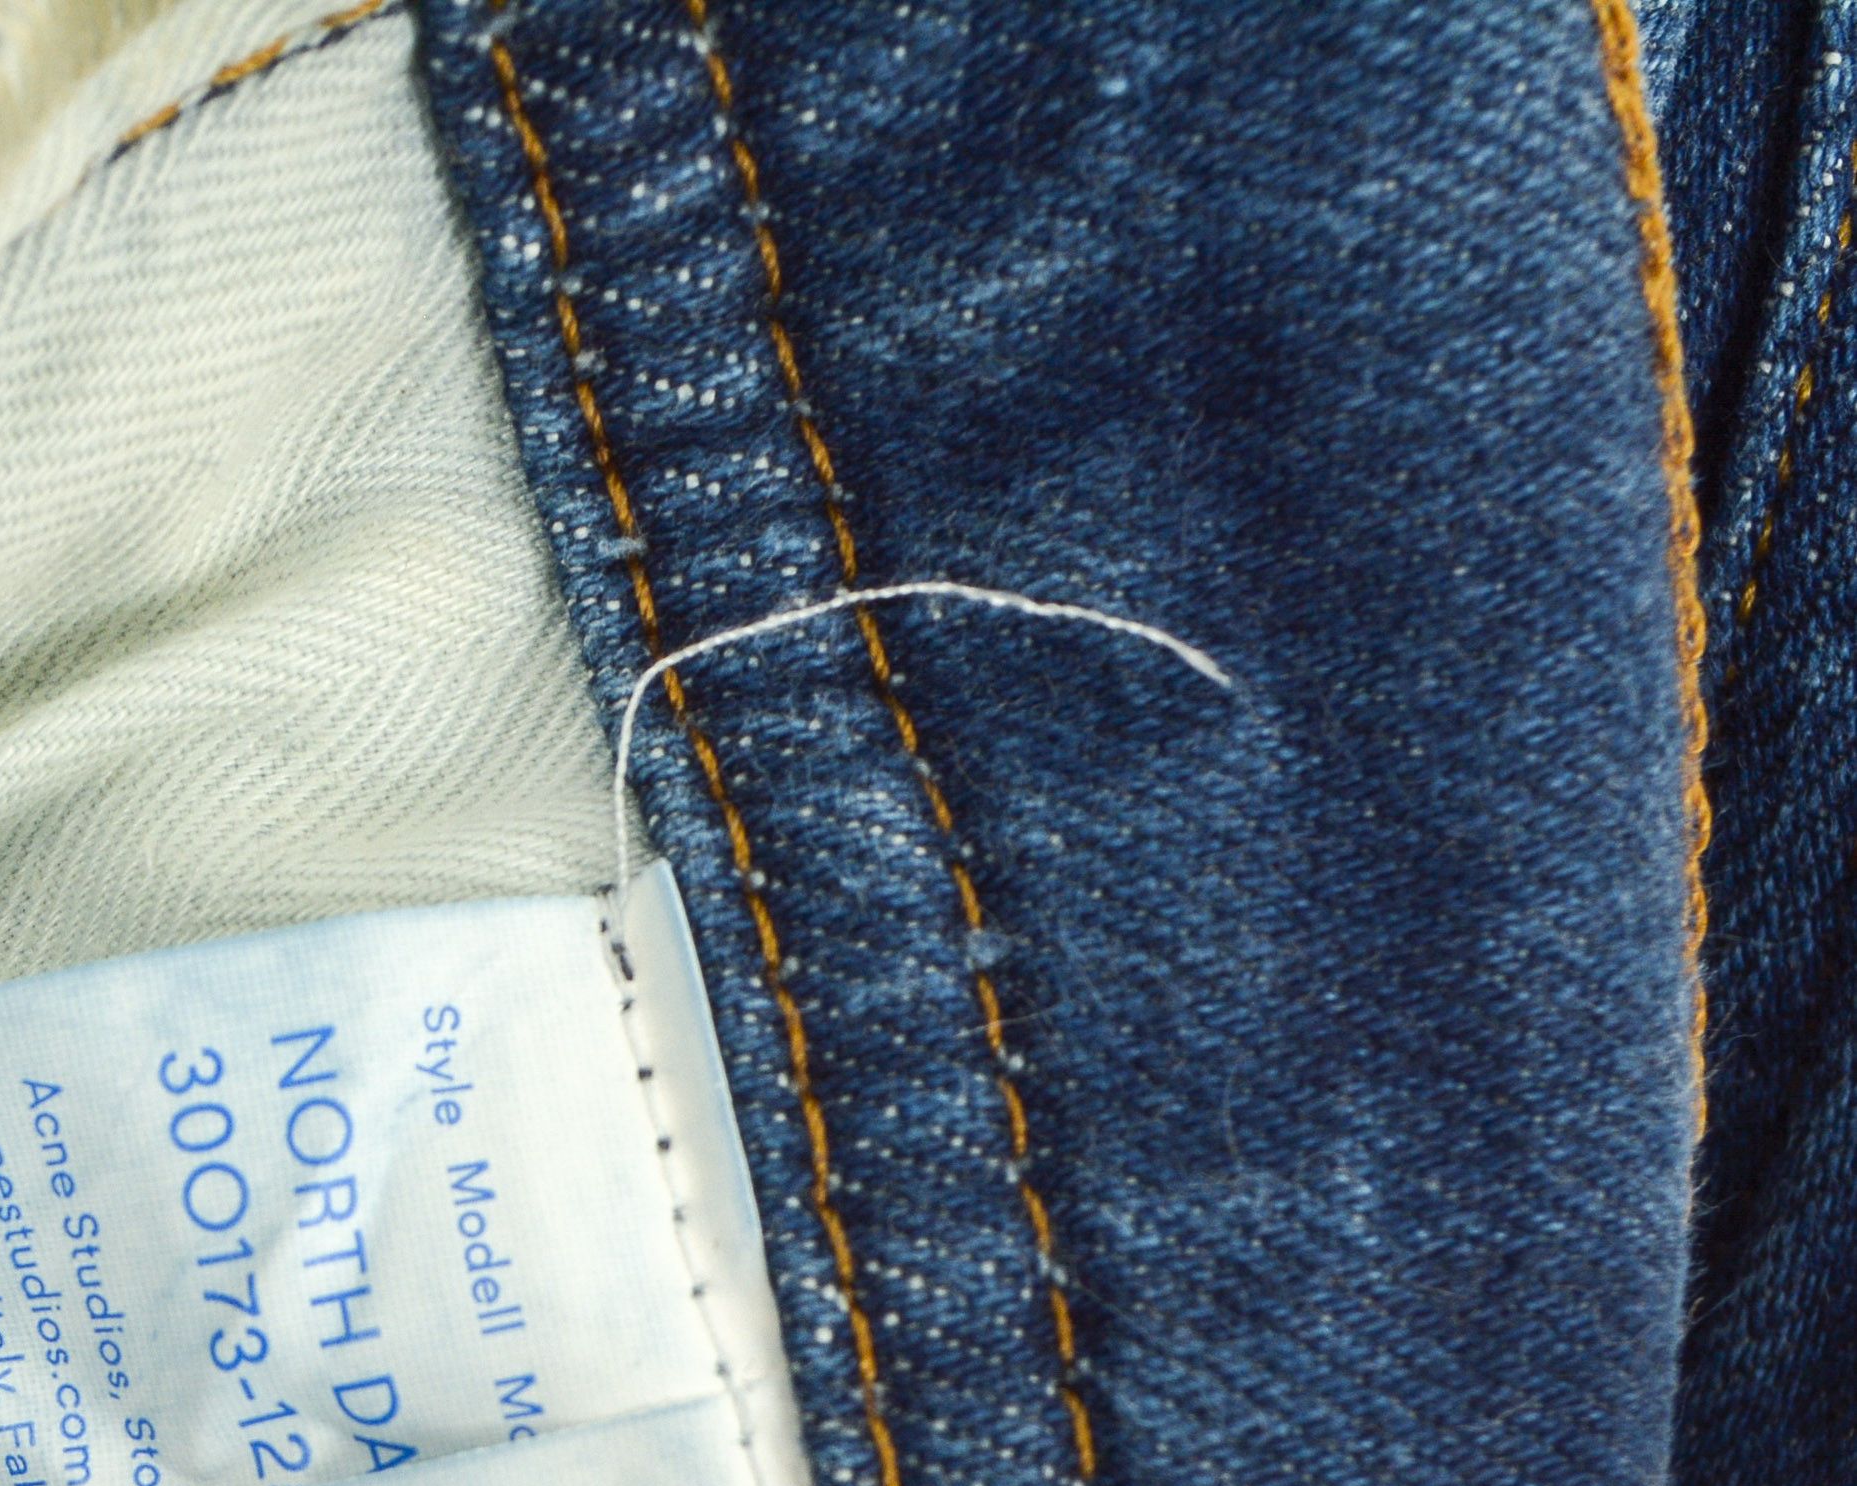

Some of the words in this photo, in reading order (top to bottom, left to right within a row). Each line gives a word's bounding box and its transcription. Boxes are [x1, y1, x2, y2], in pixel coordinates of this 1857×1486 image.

[22, 1078, 78, 1199] Acne
[62, 1212, 131, 1399] Studios,
[270, 1024, 382, 1349] NORTH
[415, 1004, 474, 1126] Style
[447, 1159, 526, 1336] Modell
